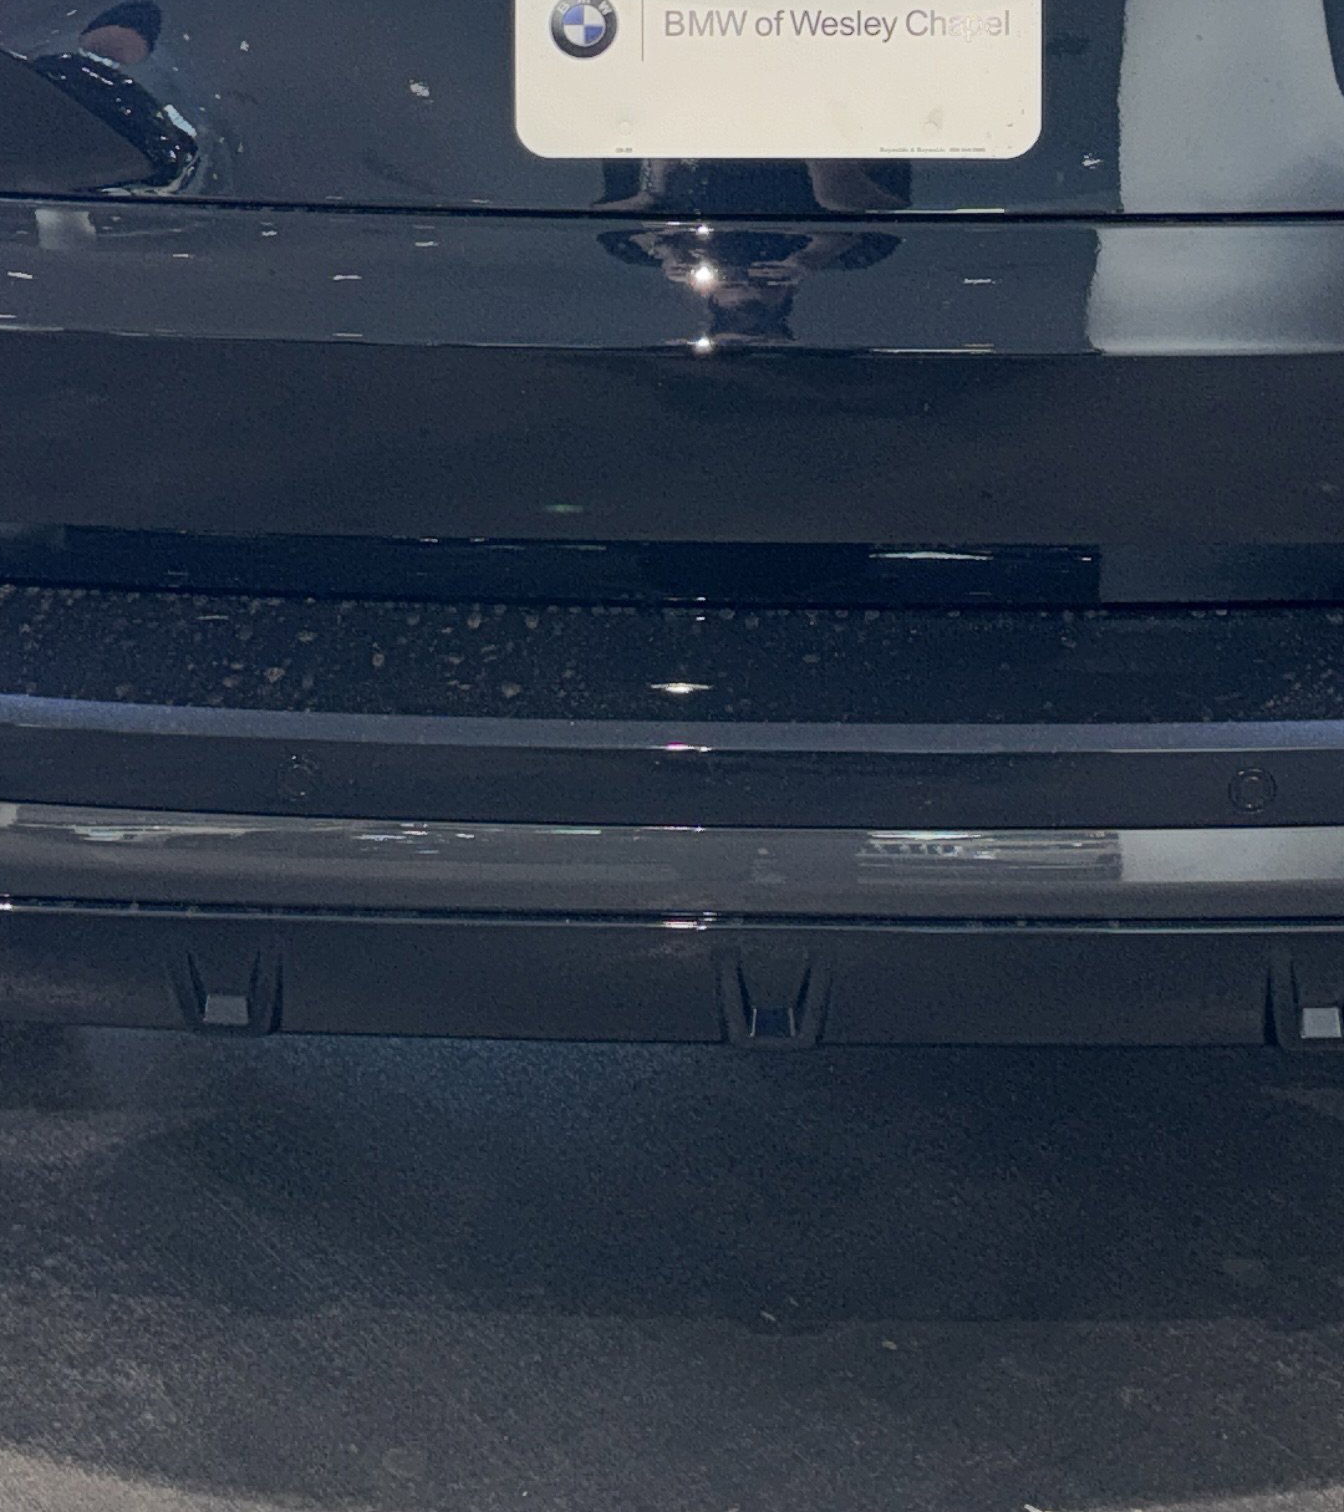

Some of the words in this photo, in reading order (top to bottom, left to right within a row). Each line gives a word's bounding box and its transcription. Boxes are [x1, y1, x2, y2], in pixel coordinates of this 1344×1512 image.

[664, 9, 748, 37] BMW
[754, 9, 785, 37] of
[789, 9, 898, 43] Wesley
